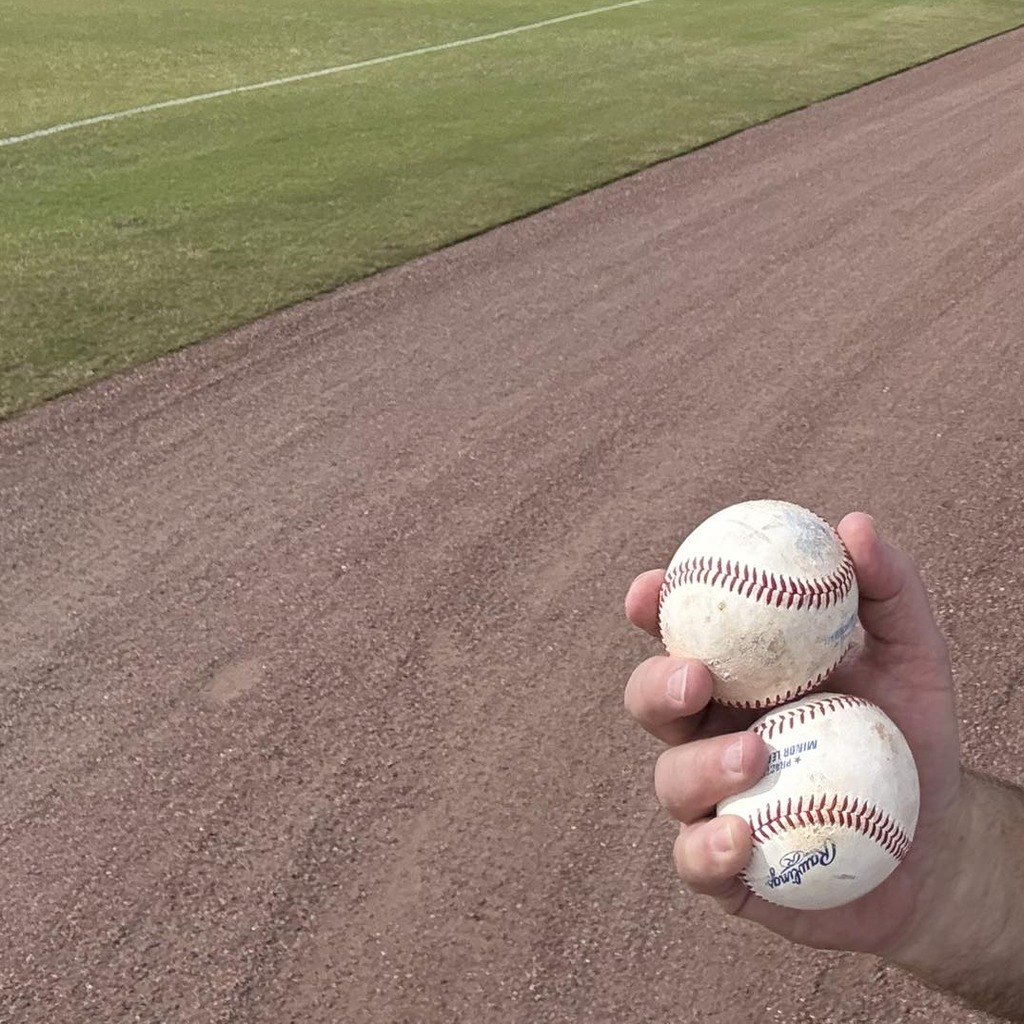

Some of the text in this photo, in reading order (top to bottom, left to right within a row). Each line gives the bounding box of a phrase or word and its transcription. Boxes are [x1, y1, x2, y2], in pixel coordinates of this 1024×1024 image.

[768, 740, 818, 764] MINOR LE
[766, 838, 837, 889] Rawlings
